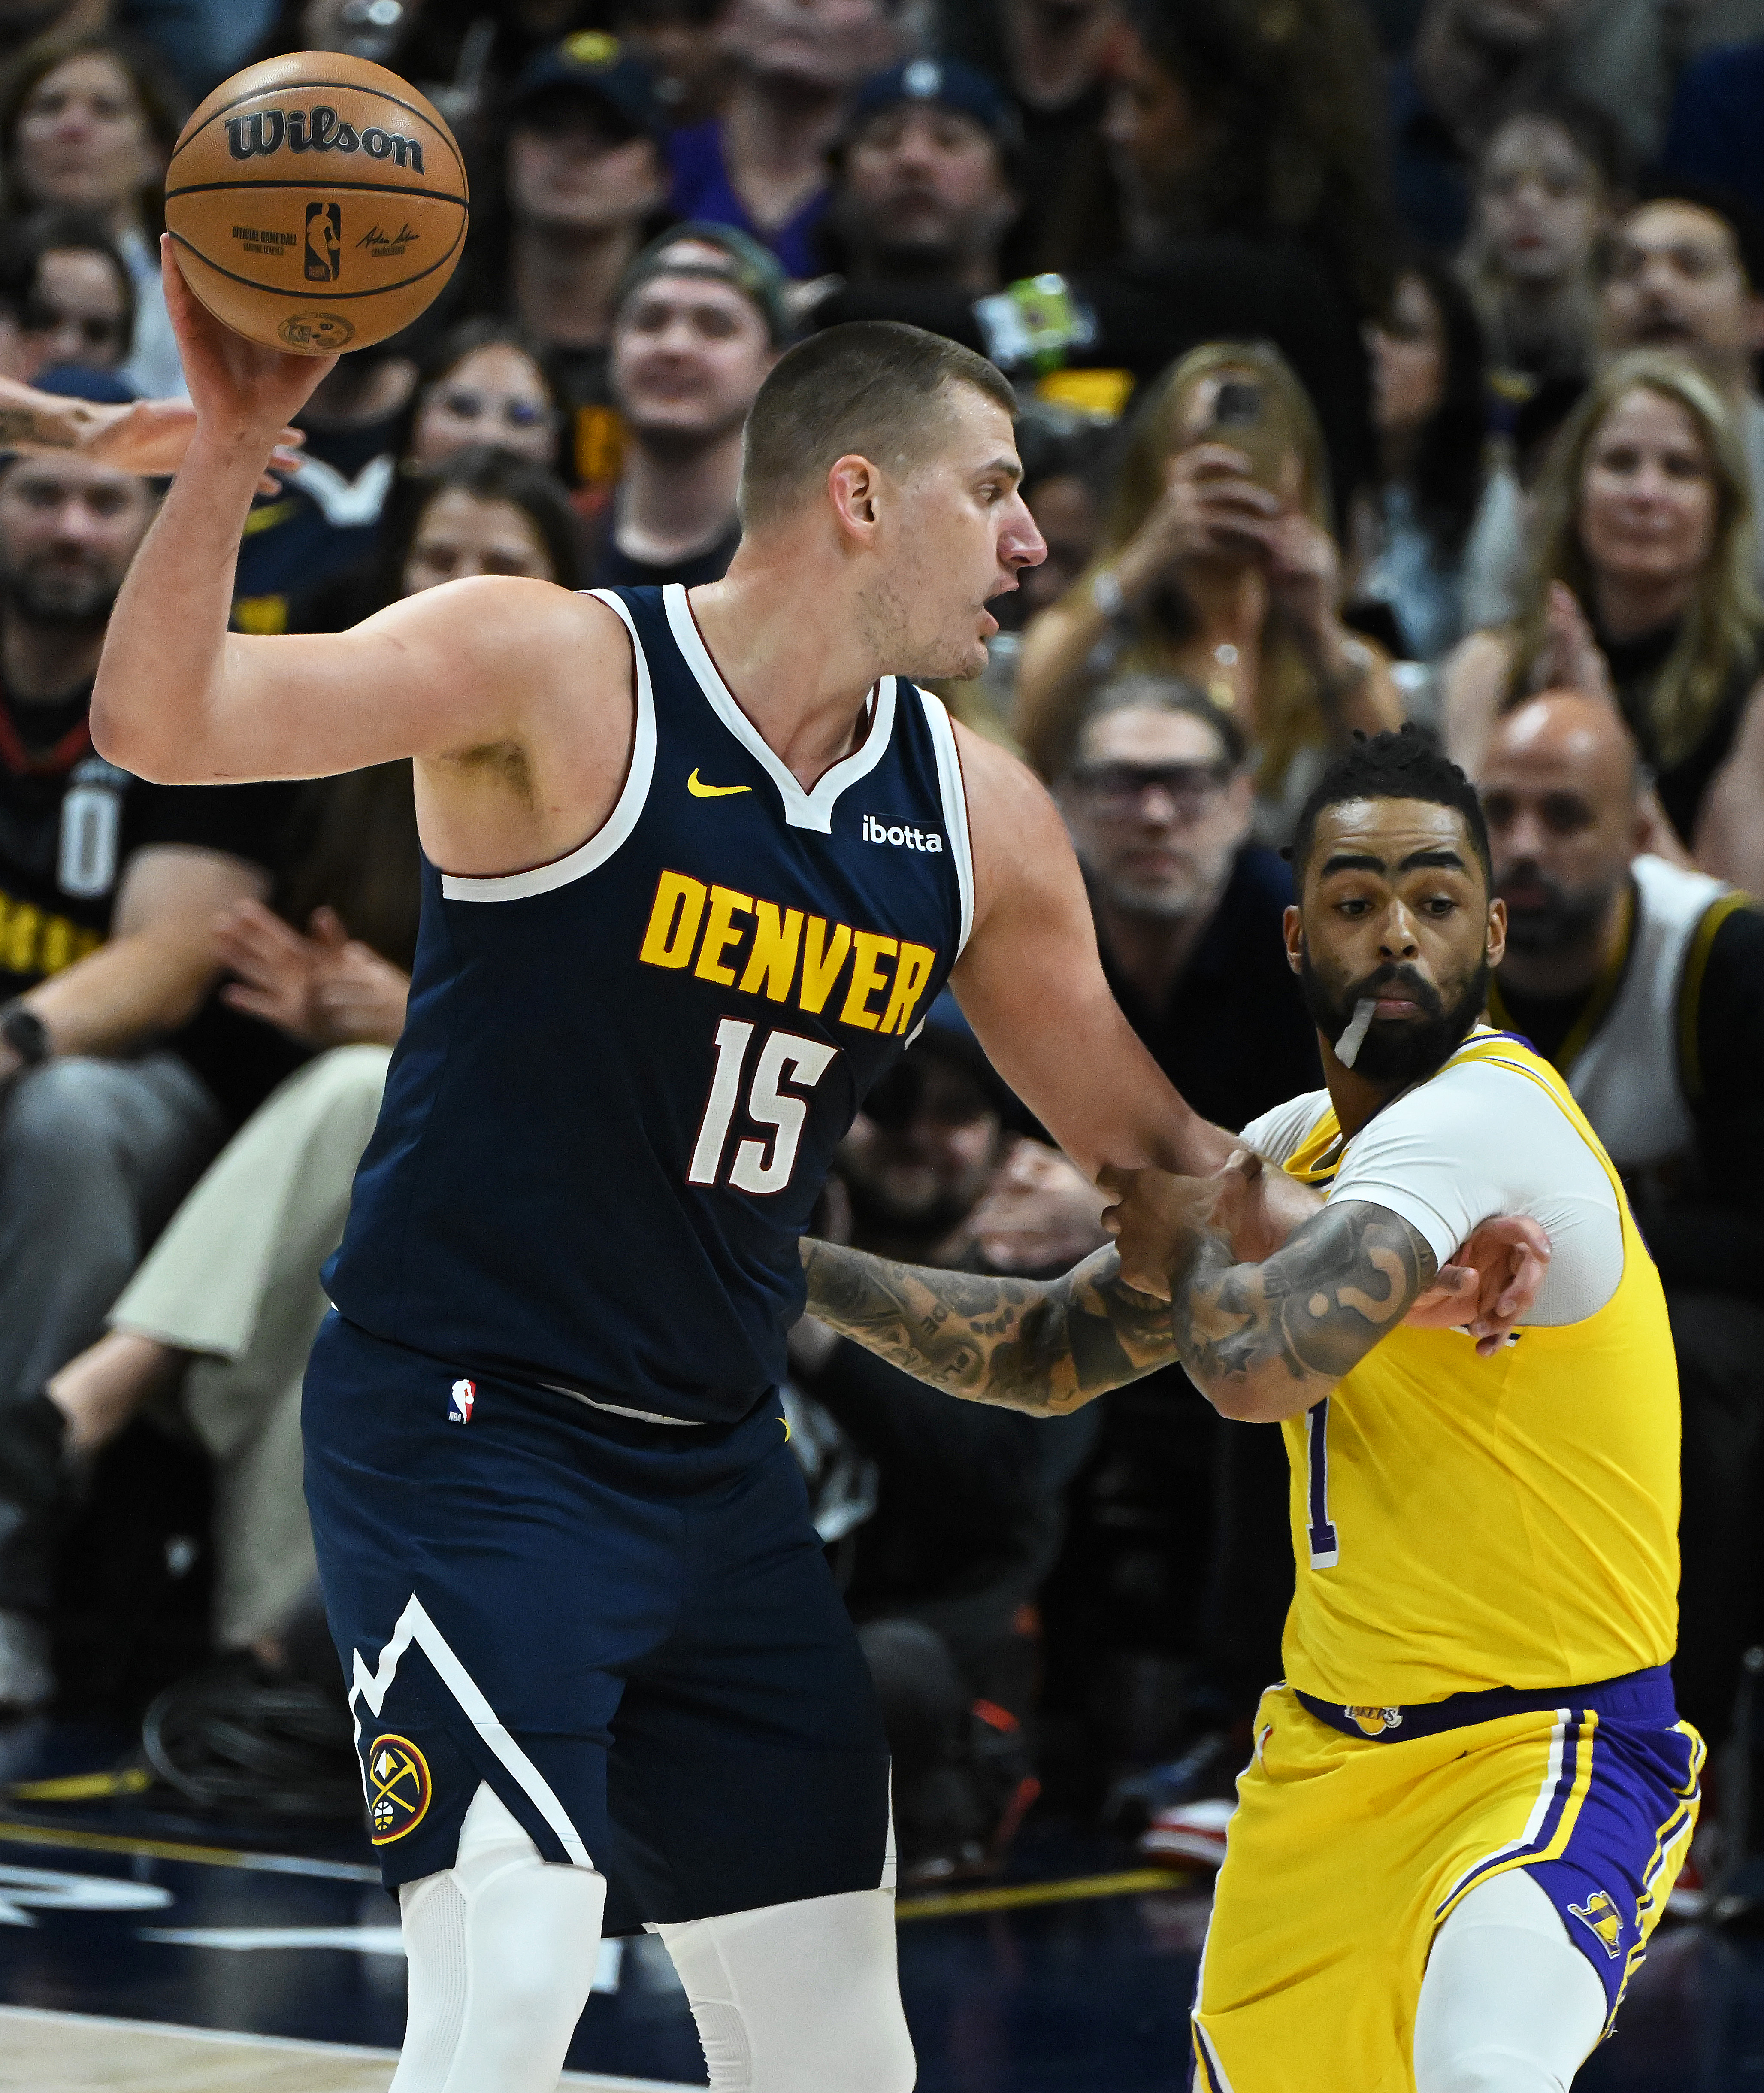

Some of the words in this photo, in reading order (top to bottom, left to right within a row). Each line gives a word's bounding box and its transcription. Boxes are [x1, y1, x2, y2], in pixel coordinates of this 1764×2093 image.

[225, 106, 424, 175] Wilson
[260, 231, 279, 244] GAME
[281, 233, 297, 245] BALL
[862, 814, 942, 853] ibotta
[638, 868, 938, 1036] DENVER
[686, 1015, 840, 1195] 15
[1304, 1396, 1339, 1570] 1
